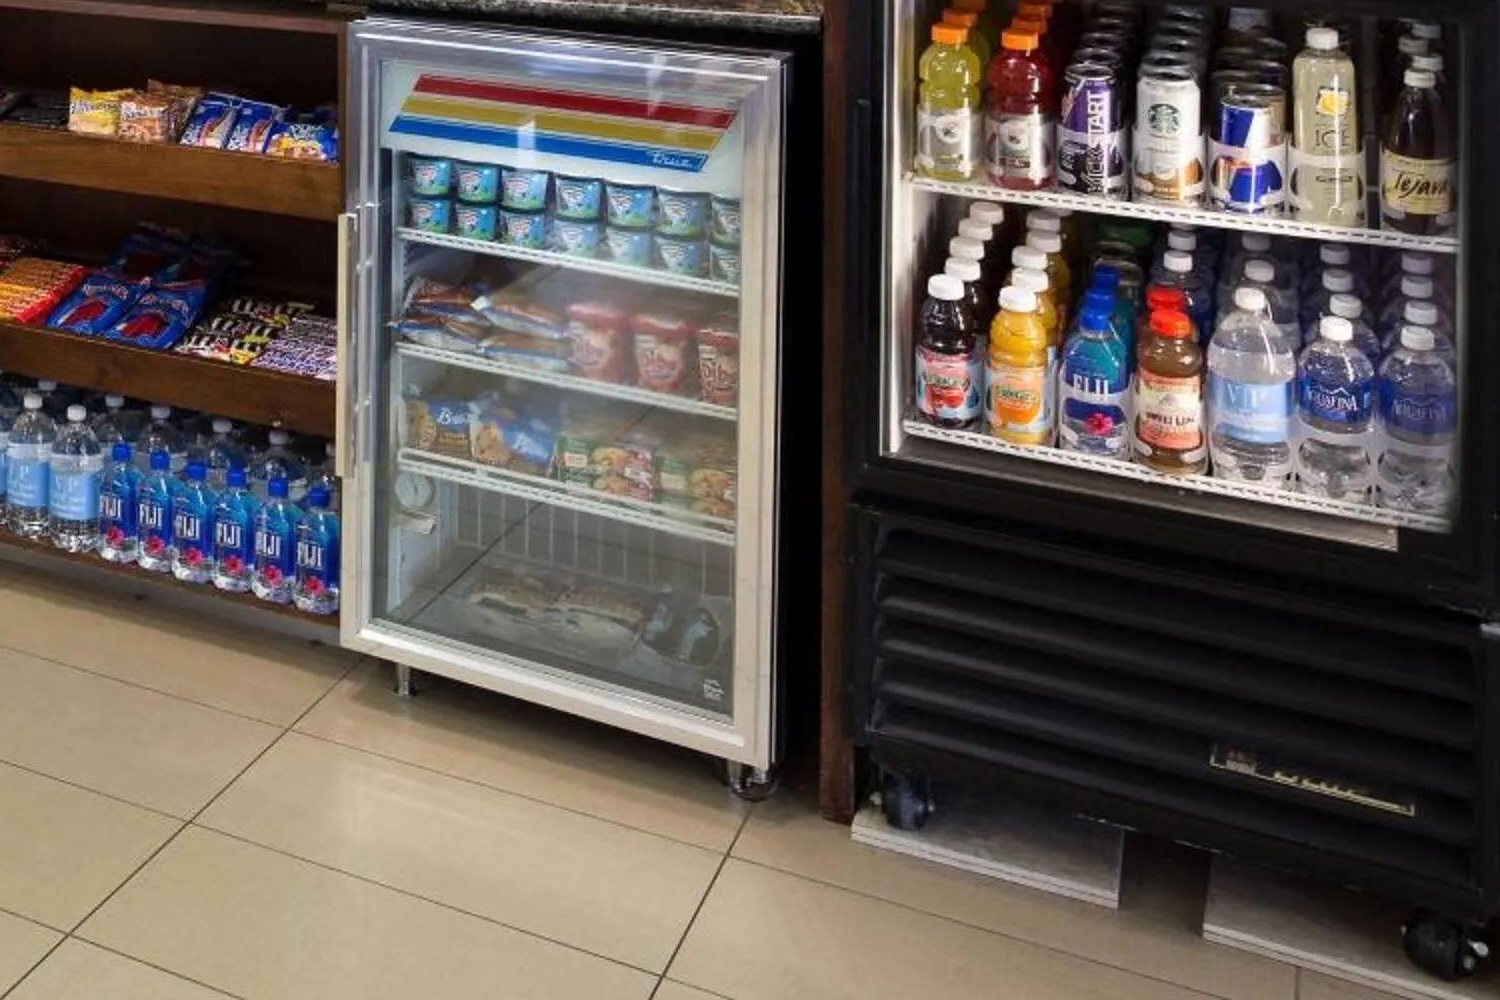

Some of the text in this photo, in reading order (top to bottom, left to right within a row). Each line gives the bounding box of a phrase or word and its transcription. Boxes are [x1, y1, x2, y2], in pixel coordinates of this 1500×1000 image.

[139, 503, 164, 530] FIJI
[175, 513, 201, 541] FIJI
[215, 522, 242, 549] FIJI
[255, 531, 281, 558] FIJI
[297, 541, 322, 570] FIJI
